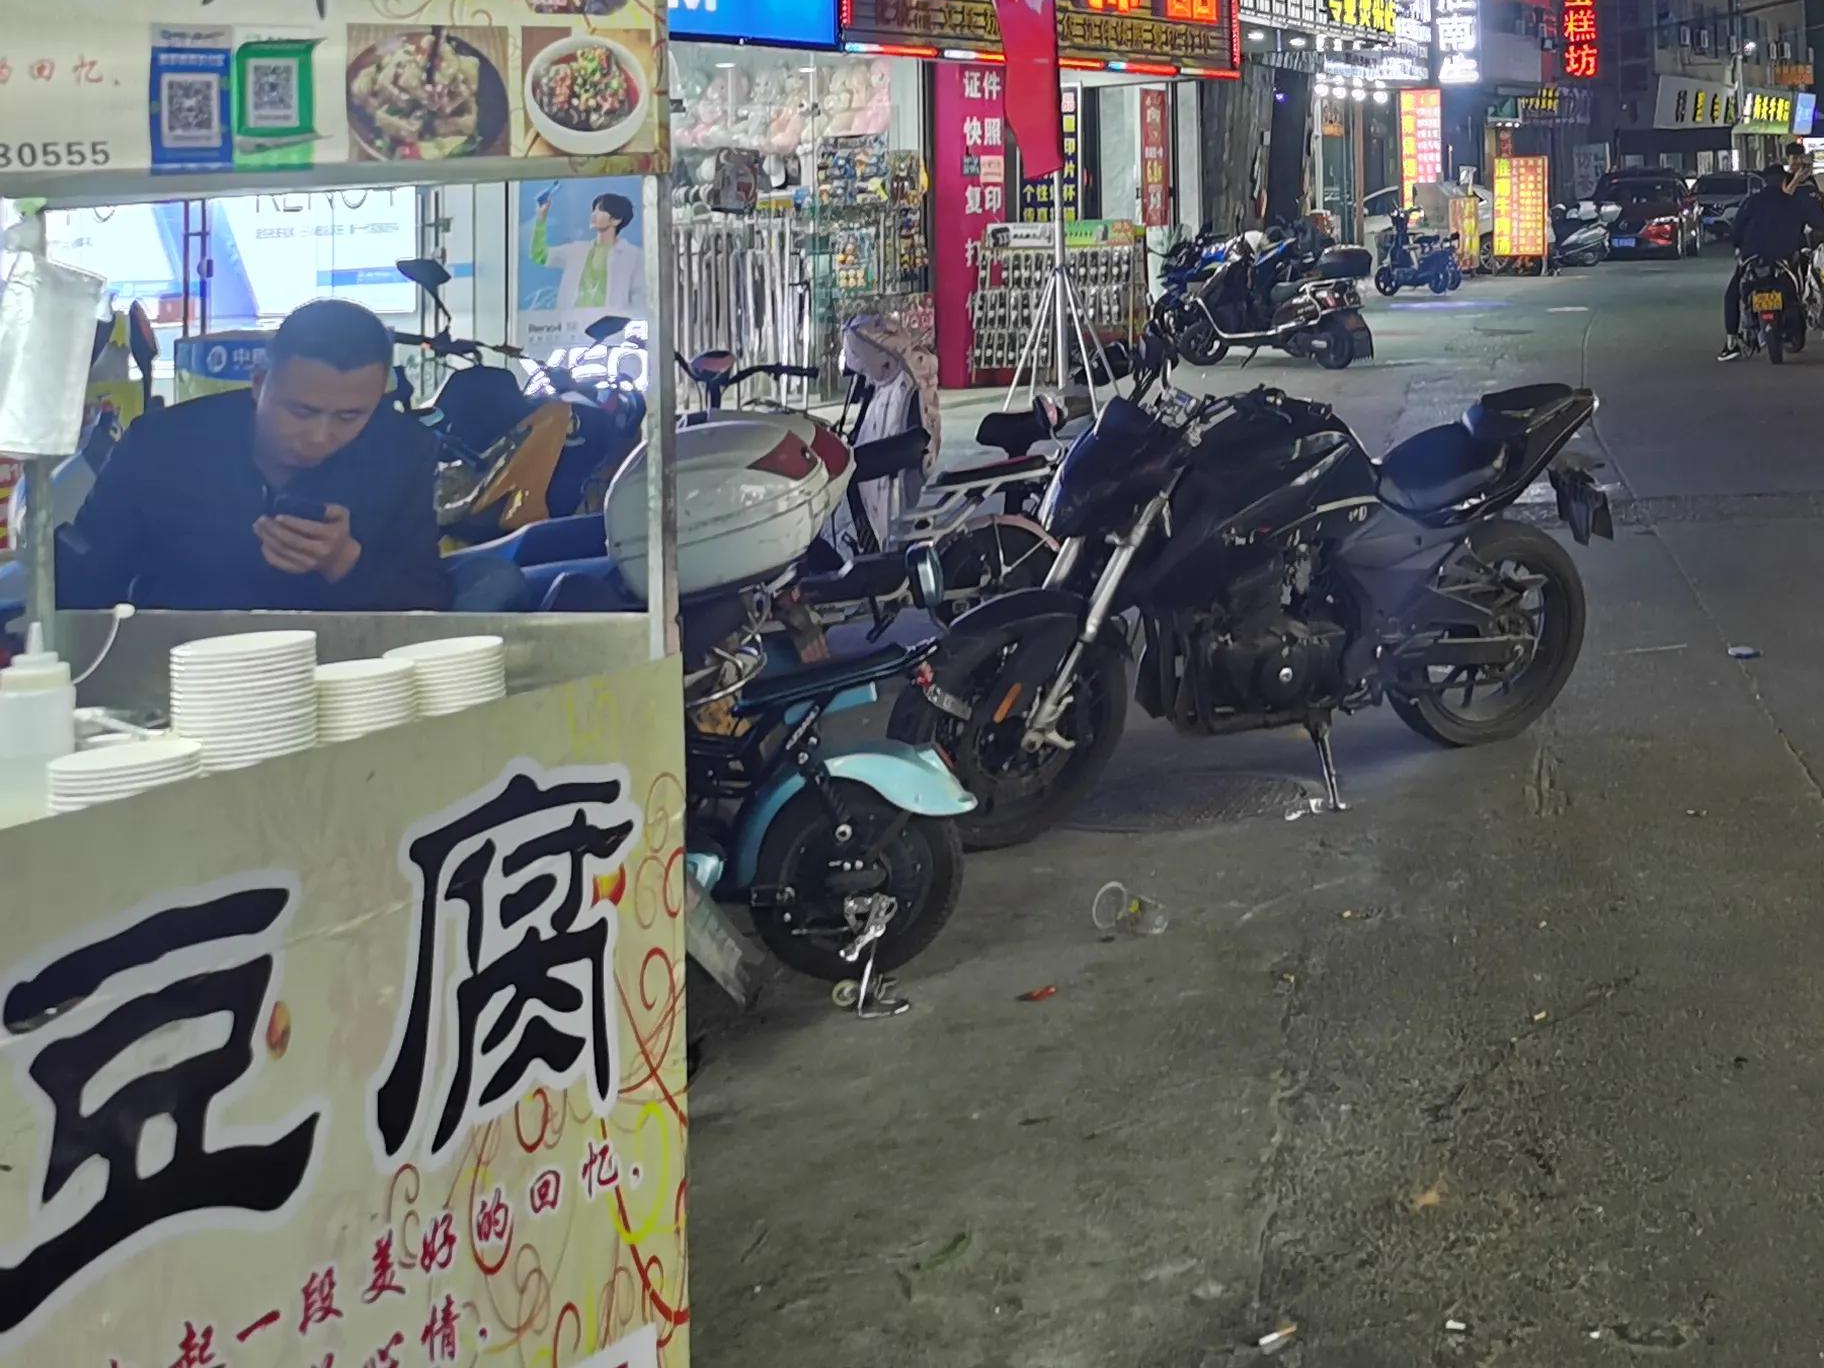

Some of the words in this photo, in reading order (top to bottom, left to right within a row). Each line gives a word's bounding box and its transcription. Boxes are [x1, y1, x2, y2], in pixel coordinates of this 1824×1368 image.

[963, 70, 1001, 101] 证件
[963, 116, 1002, 147] 快照
[964, 183, 1002, 216] 复印
[0, 773, 635, 1332] 豆腐
[108, 1142, 641, 1368] 起一段美好的回忆.
